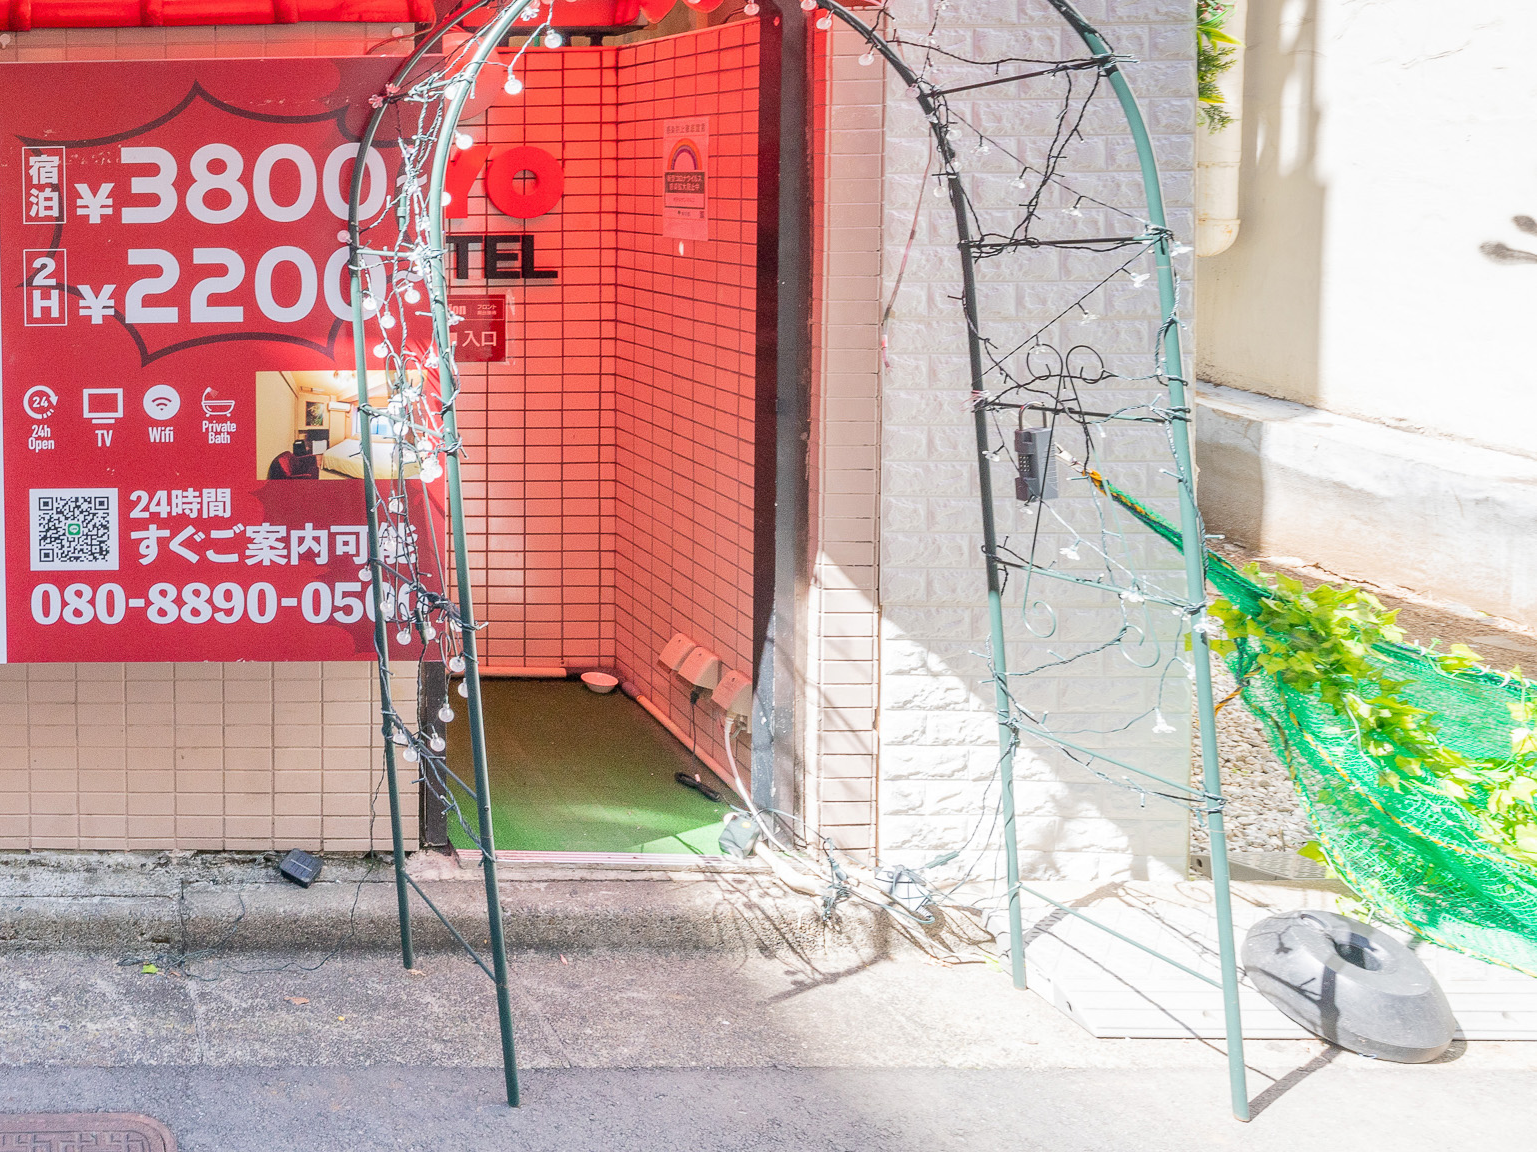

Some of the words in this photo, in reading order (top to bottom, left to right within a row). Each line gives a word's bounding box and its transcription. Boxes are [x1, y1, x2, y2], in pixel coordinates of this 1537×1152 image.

[28, 154, 60, 218] 宿泊
[31, 257, 60, 318] 2H
[462, 330, 497, 347] 入口
[32, 397, 48, 408] 24
[31, 425, 51, 438] 24h
[148, 426, 174, 443] Wifi
[202, 420, 236, 433] Private
[28, 437, 55, 453] Open
[95, 430, 113, 447] TV
[208, 432, 230, 444] Bath
[129, 488, 231, 519] 24時間
[130, 522, 418, 566] すぐご案内可能
